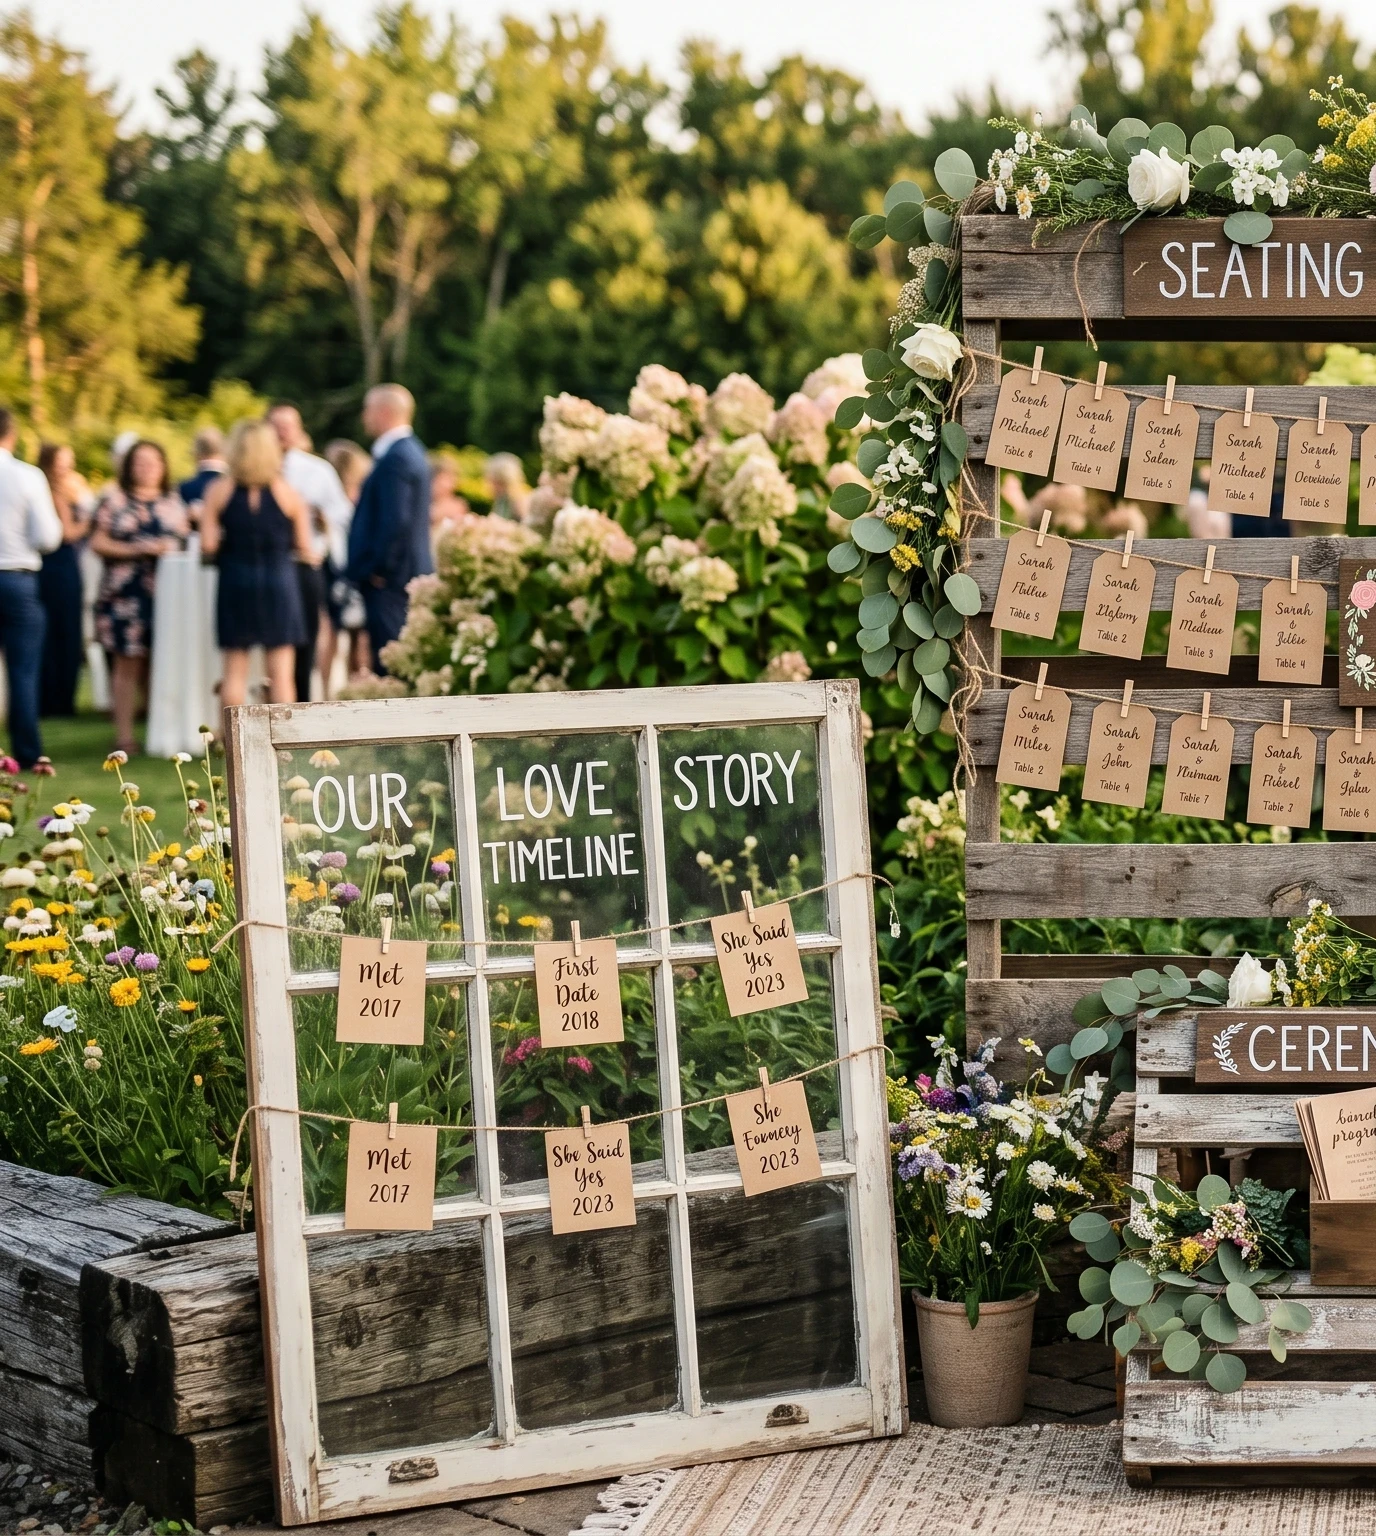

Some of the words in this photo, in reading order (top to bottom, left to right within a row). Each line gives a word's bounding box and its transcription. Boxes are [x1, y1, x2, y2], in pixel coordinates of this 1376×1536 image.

[1160, 242, 1363, 298] SEATING
[1094, 464, 1102, 475] 4
[1120, 632, 1128, 644] 2
[1207, 648, 1214, 659] 3
[1337, 749, 1376, 765] Sarah
[1036, 764, 1044, 775] 2
[312, 772, 414, 833] OUR
[497, 761, 612, 820] LOVE
[674, 750, 801, 810] STORY
[1202, 793, 1210, 805] 7
[1338, 806, 1361, 818] Table
[482, 833, 639, 884] TIMELINE
[753, 919, 790, 945] Said
[360, 962, 403, 988] Met
[552, 956, 599, 982] First
[555, 983, 599, 1006] Date
[745, 973, 785, 998] 2023
[360, 998, 400, 1017] 2017
[562, 1011, 598, 1031] 2018
[754, 1102, 781, 1124] She
[368, 1148, 411, 1174] Met
[587, 1139, 624, 1163] Said
[760, 1148, 799, 1173] 2023
[575, 1167, 606, 1192] Yes
[369, 1184, 409, 1203] 2017
[573, 1194, 613, 1216] 2023
